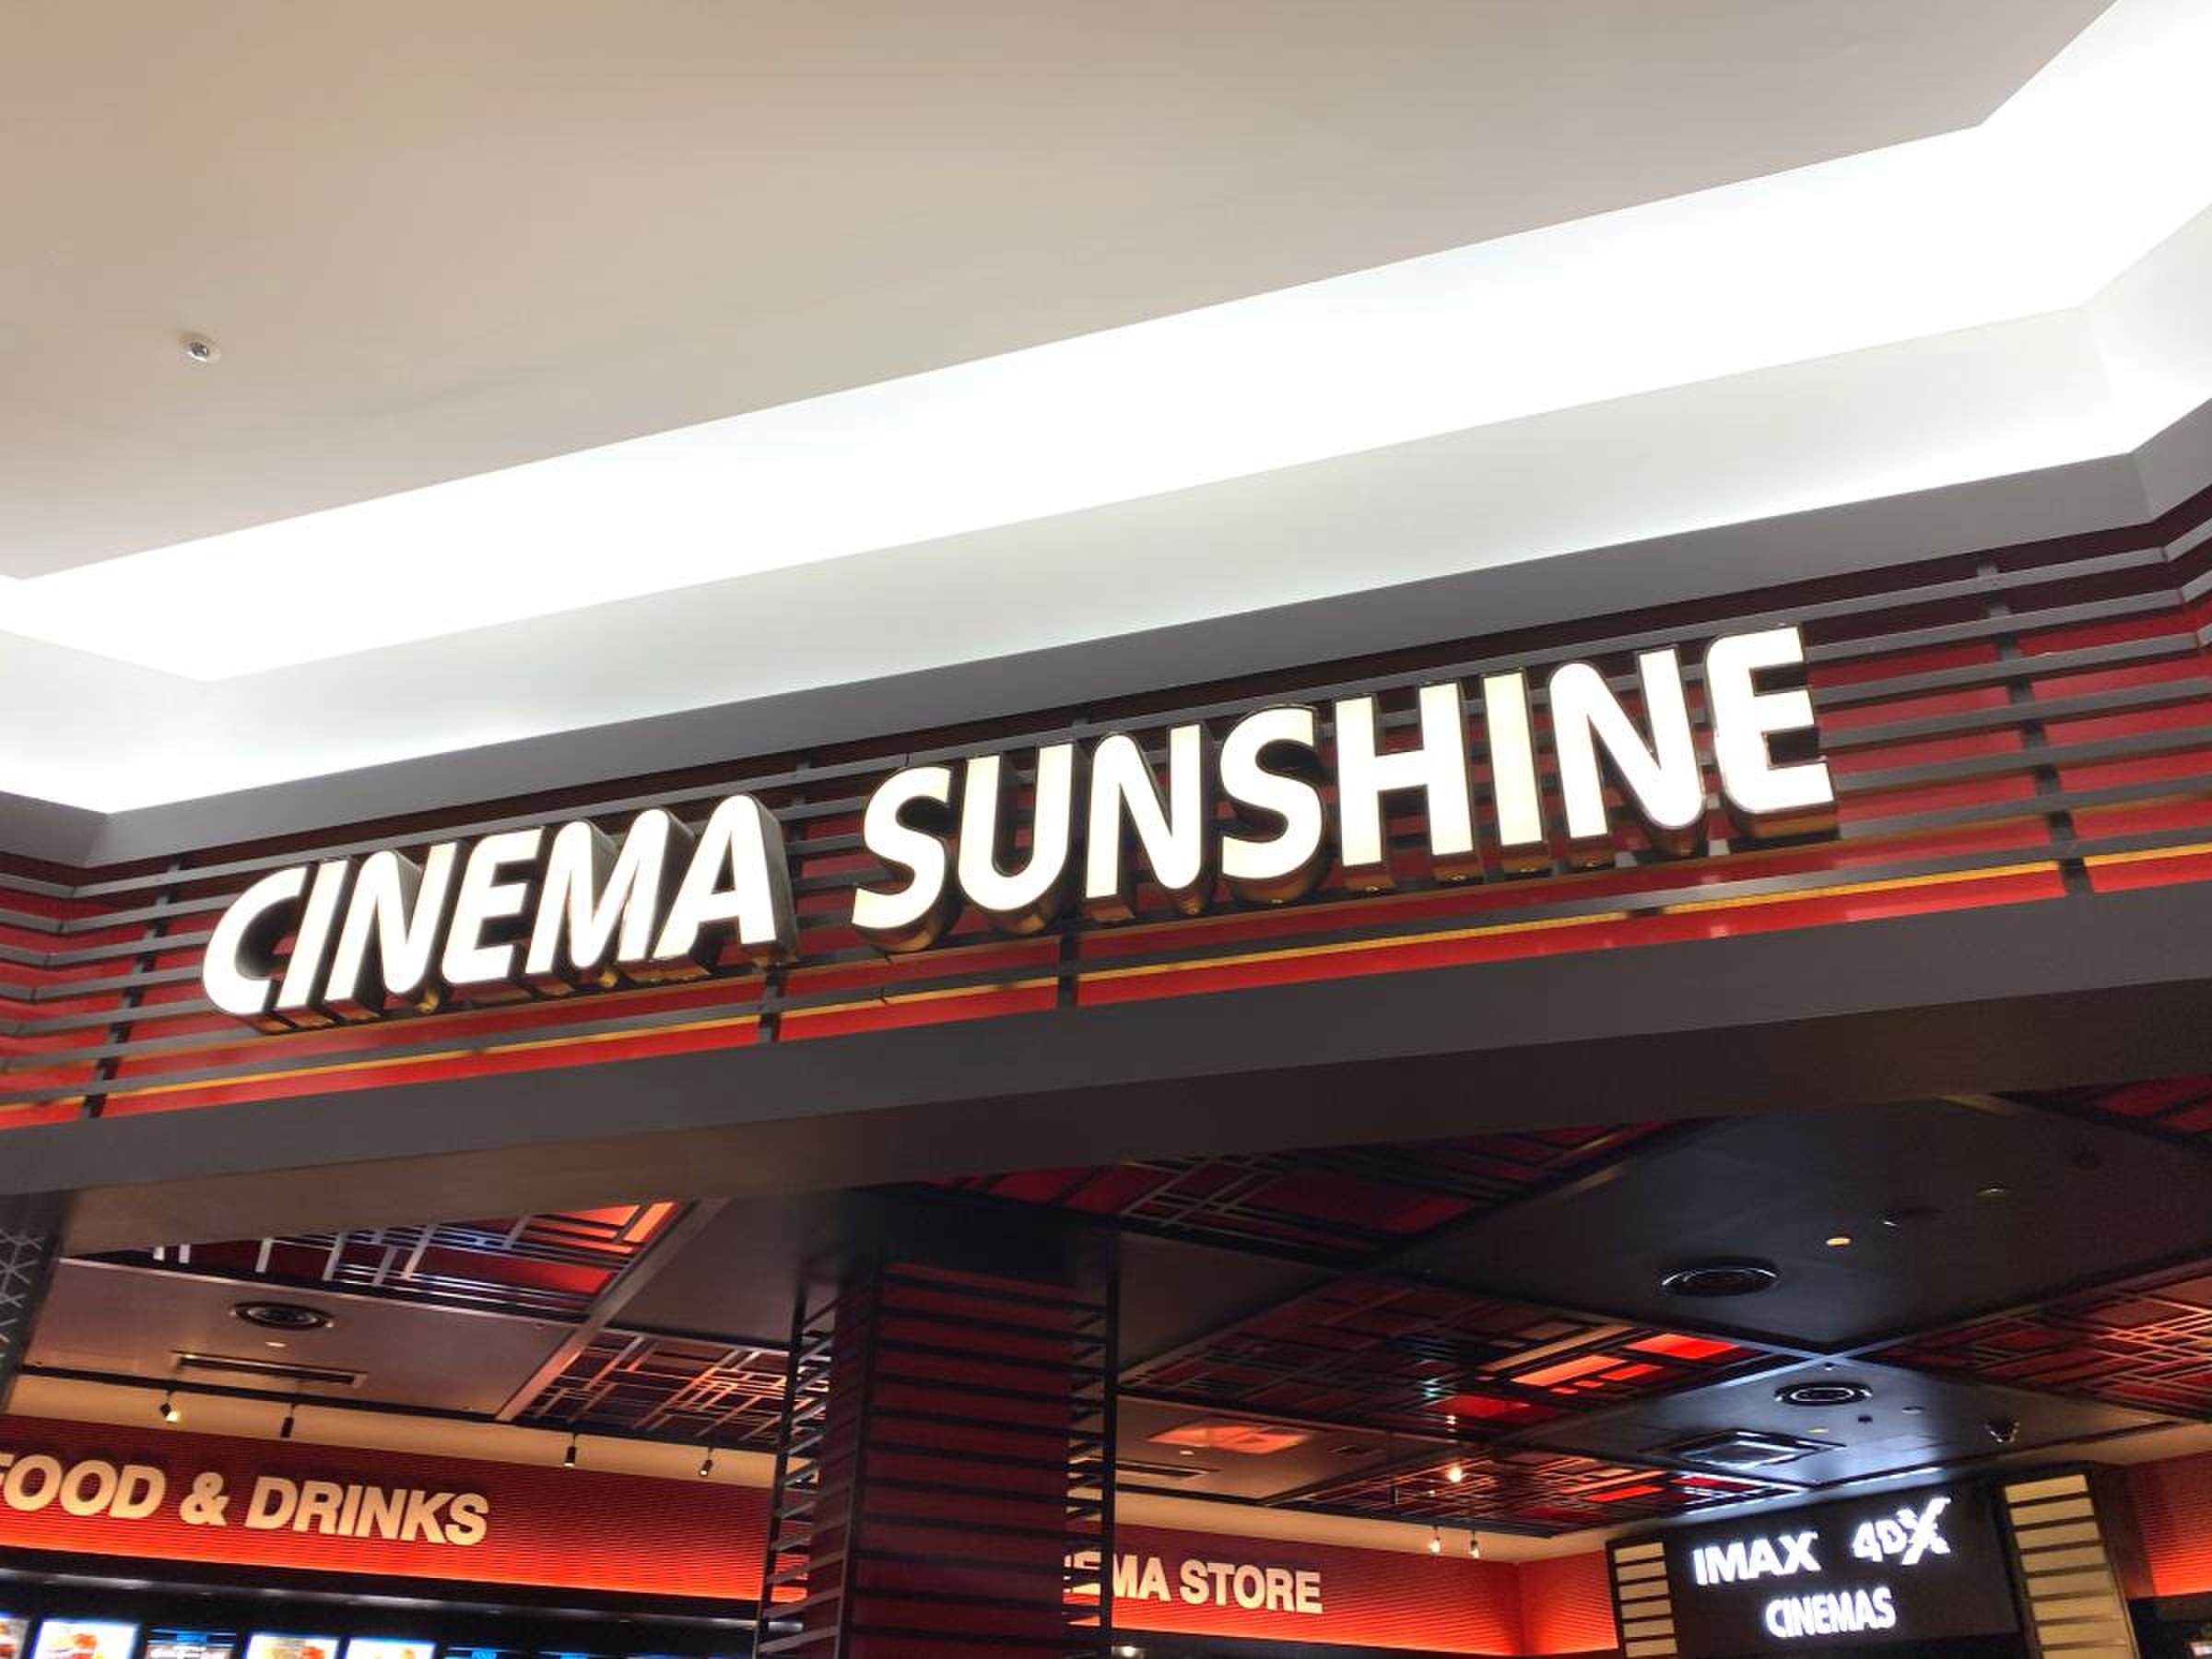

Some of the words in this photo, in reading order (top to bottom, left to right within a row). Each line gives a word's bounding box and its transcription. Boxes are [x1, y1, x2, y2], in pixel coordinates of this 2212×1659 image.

[202, 794, 776, 1016] CINEMA
[851, 625, 1835, 929] SUNSHINE
[180, 1472, 229, 1526] &
[245, 1477, 488, 1545] DRINKS
[1690, 1530, 1821, 1585] IMAX
[1852, 1498, 1951, 1565] 4DX
[1179, 1559, 1324, 1614] STORE
[1764, 1587, 1896, 1637] CINEMAS
